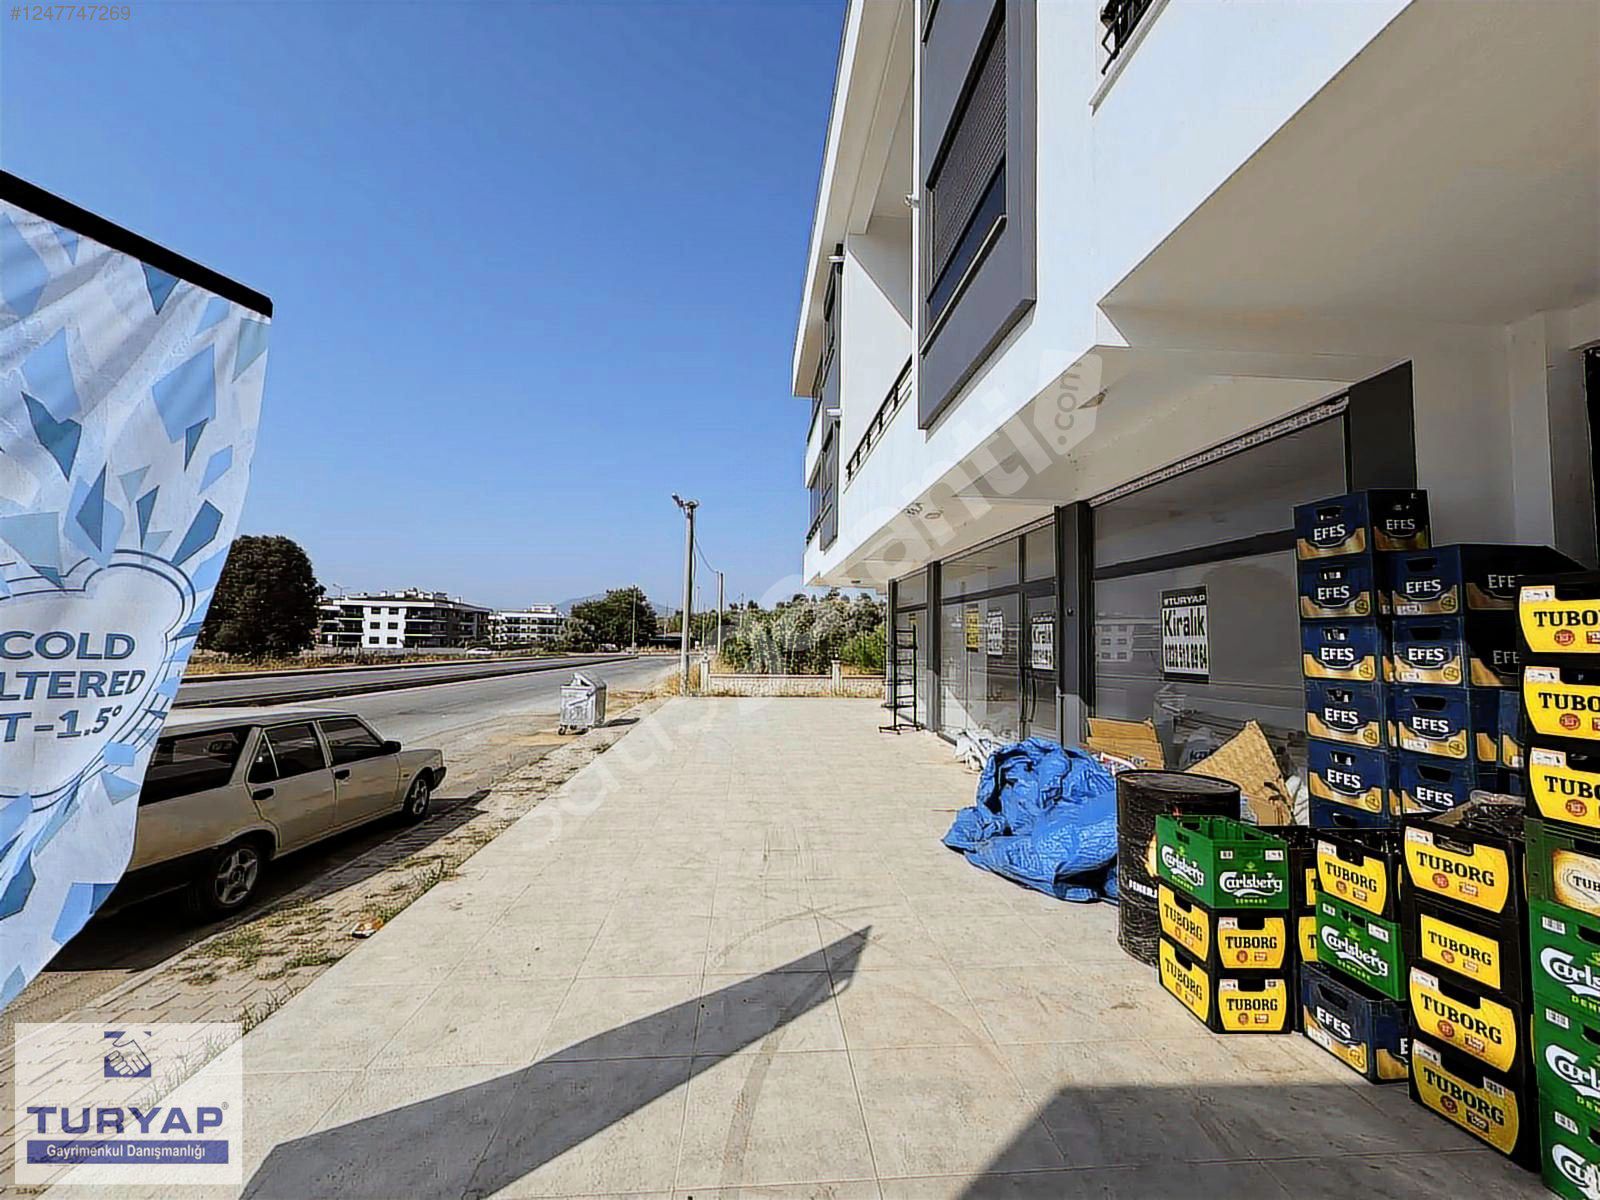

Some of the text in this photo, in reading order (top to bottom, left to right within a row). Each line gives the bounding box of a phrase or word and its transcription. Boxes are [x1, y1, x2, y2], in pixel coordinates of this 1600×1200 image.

[1313, 524, 1346, 541] EFES
[1386, 518, 1416, 531] EFES
[1405, 579, 1442, 594] EFES
[1487, 574, 1515, 589] EFE
[1317, 585, 1350, 600] EFES
[1533, 609, 1600, 628] TUBO
[0, 630, 136, 660] COLD
[1320, 647, 1354, 662] EFES
[1408, 647, 1445, 662] EFES
[1492, 650, 1520, 665] EFE
[0, 670, 146, 701] LTERED
[1538, 692, 1600, 713] TUBO
[0, 712, 32, 742] T
[1324, 708, 1359, 725] EFES
[1412, 716, 1449, 733] EFES
[1327, 768, 1361, 789] EFES
[1416, 786, 1454, 807] EFES
[1325, 861, 1377, 893] TUBORG
[1416, 851, 1495, 887] TUBORG
[1219, 871, 1283, 897] Carlsberg
[1573, 875, 1600, 892] TUB
[1164, 903, 1202, 941] TUBORG
[1225, 936, 1277, 949] TUBORG
[1321, 925, 1388, 977] Carlsberg
[1428, 930, 1493, 966] TUBORG
[1165, 958, 1202, 1000] TUBORG
[1226, 998, 1278, 1011] TUBORG
[1316, 1006, 1351, 1039] EFES
[1421, 993, 1502, 1045] TUBORG
[1424, 1067, 1504, 1125] TUBORG
